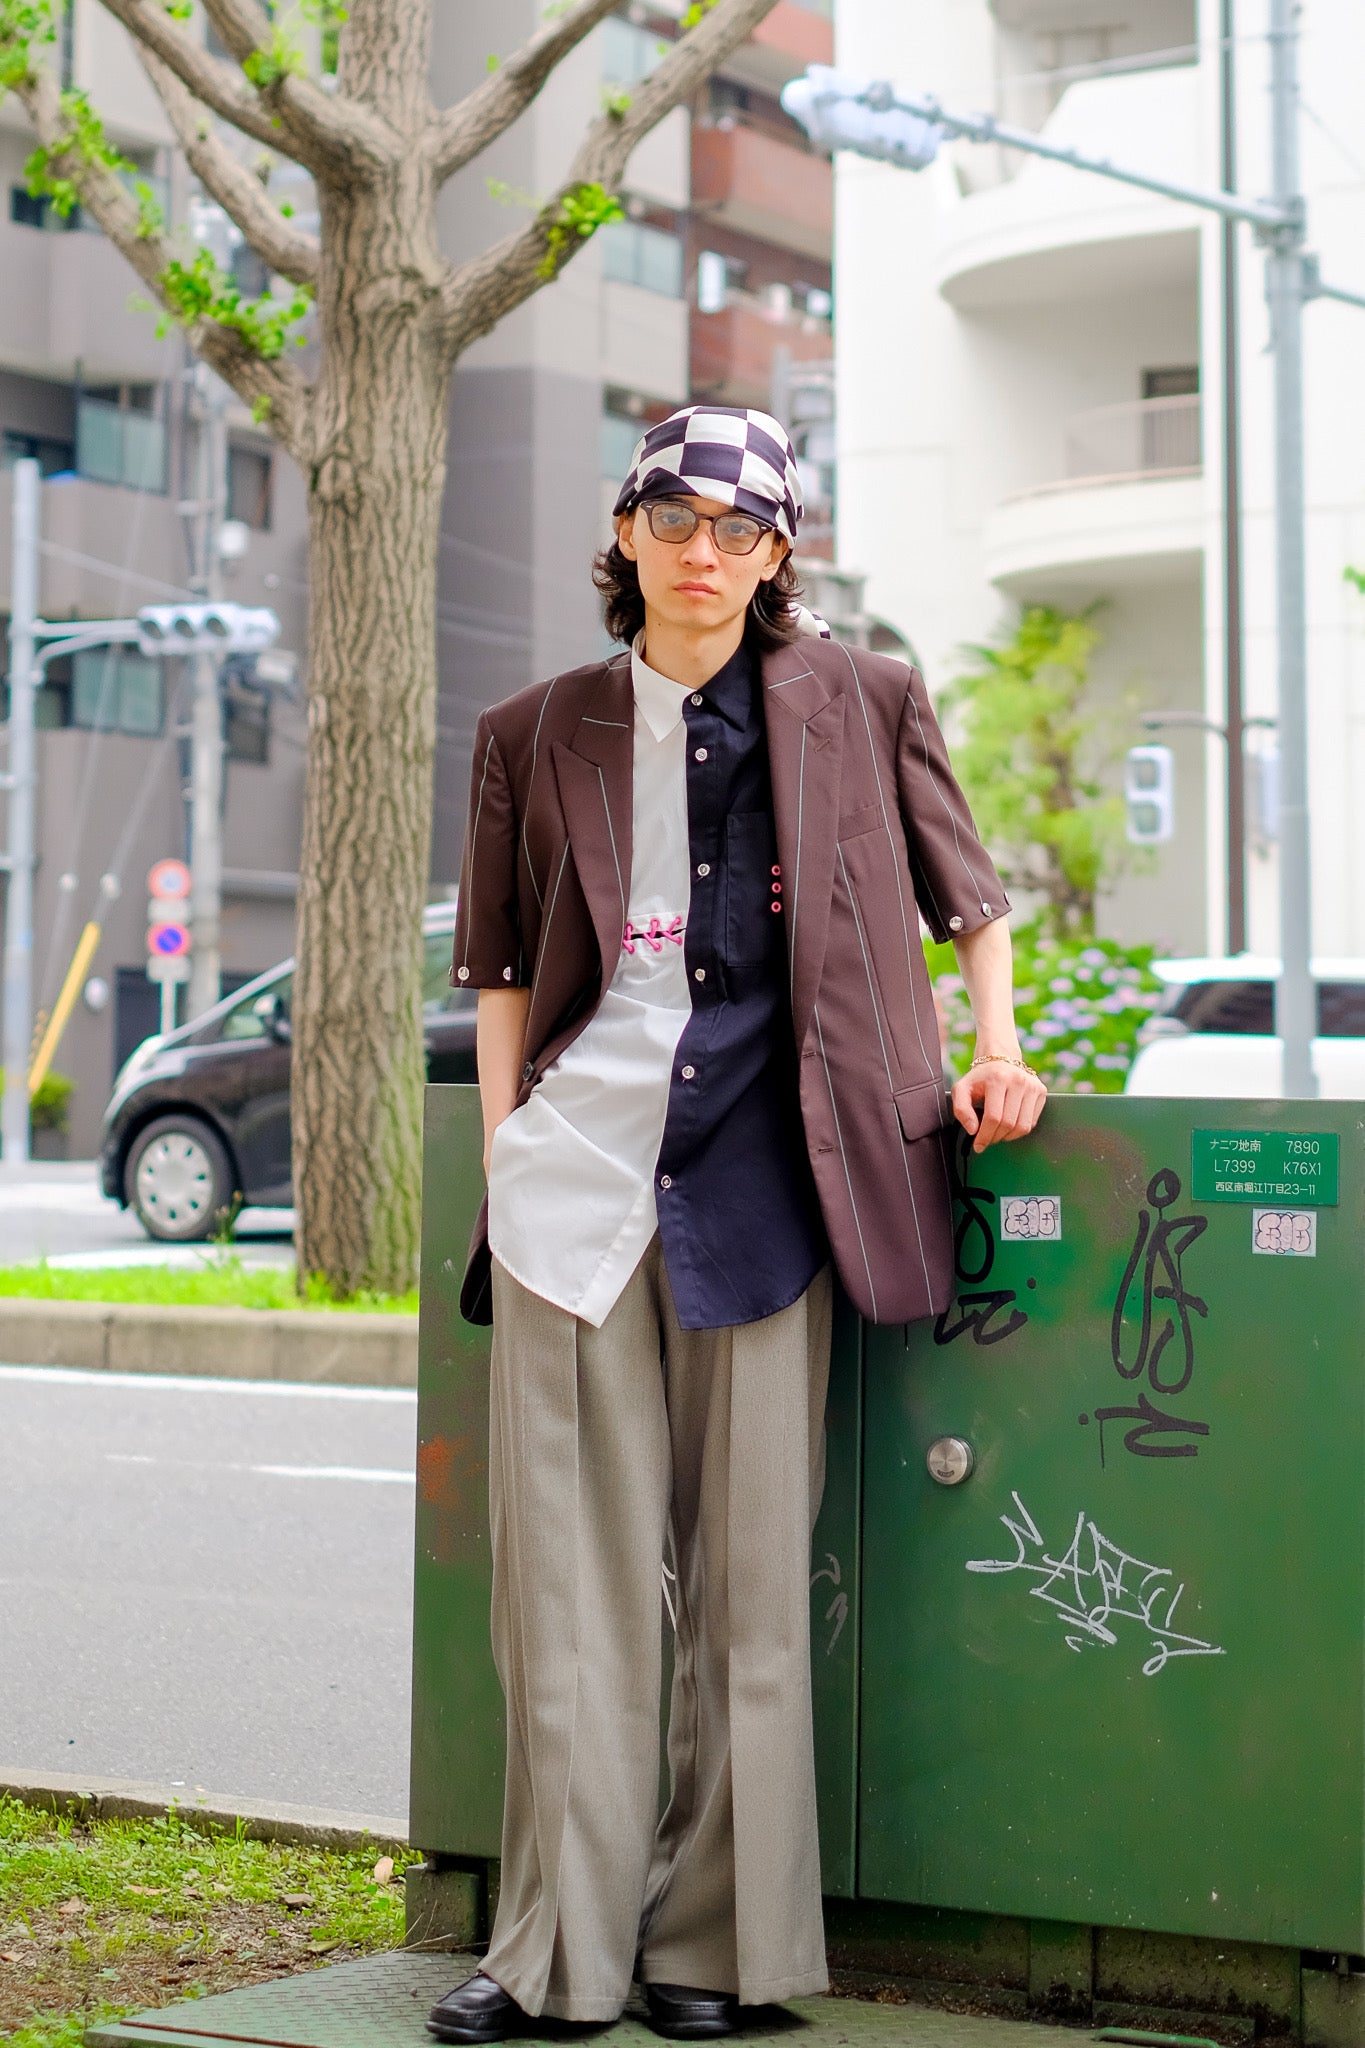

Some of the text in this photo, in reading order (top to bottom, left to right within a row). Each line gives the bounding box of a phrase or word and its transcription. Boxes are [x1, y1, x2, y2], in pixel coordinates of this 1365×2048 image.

[1210, 1139, 1319, 1154] ナニワ地南 7890
[1214, 1159, 1321, 1175] L7399 K76X1
